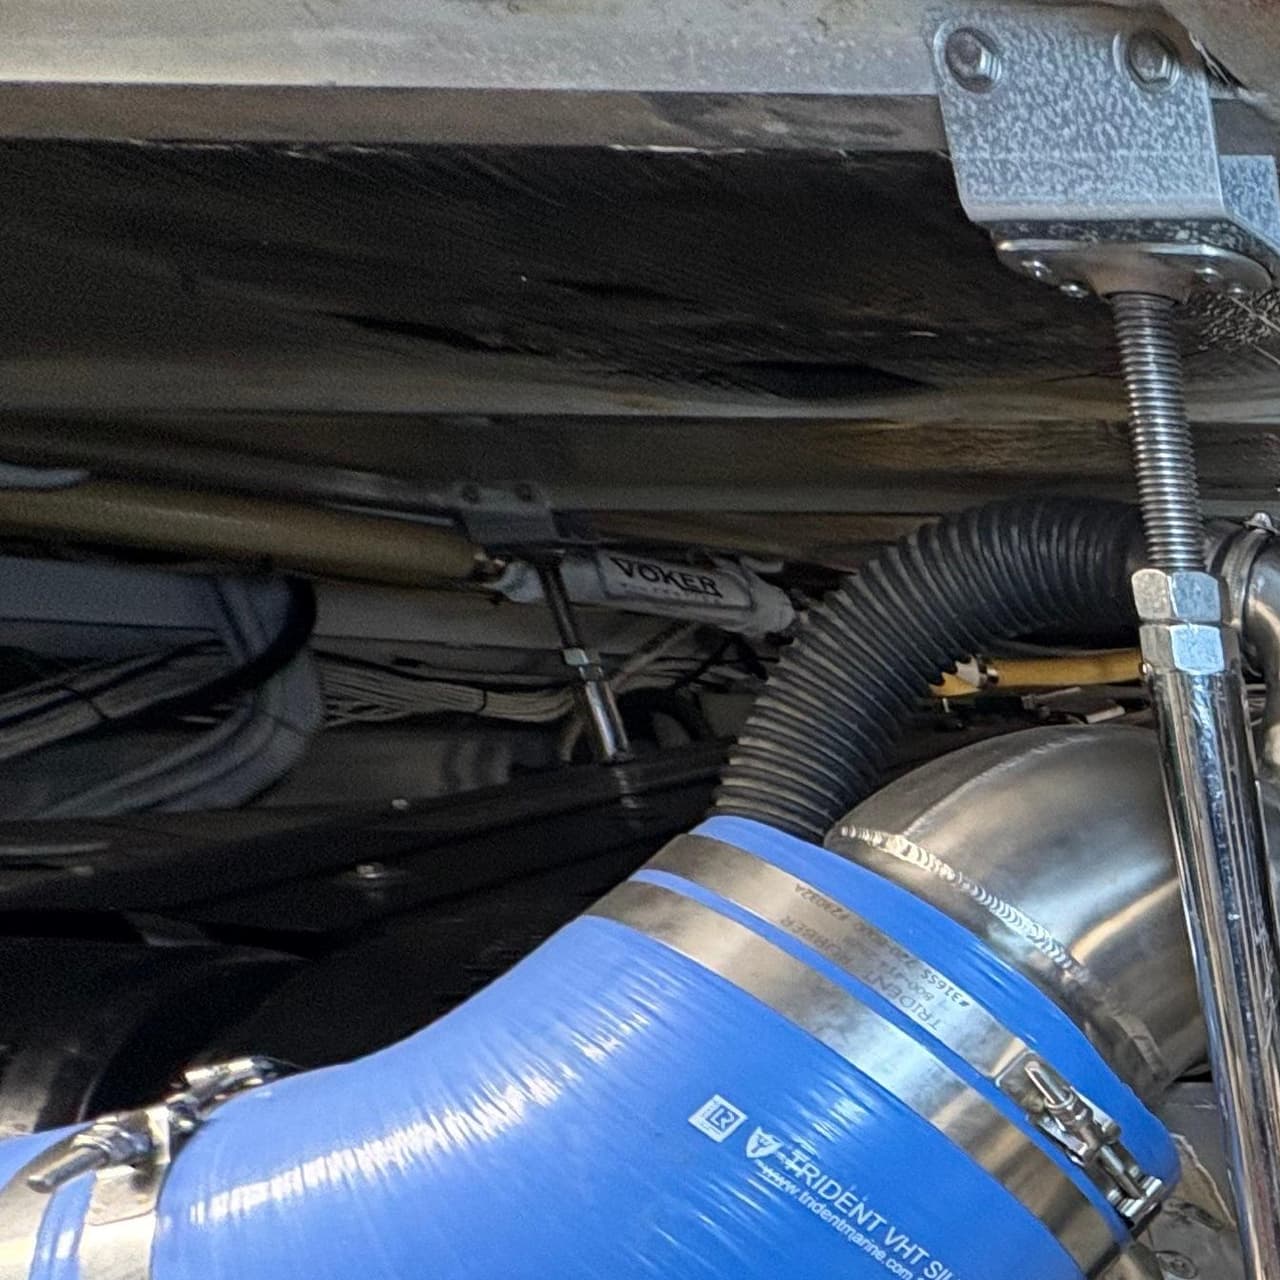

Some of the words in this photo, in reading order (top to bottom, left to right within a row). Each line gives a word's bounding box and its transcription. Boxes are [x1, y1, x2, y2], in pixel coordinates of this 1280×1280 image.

[864, 968, 943, 1032] TRIDENT
[784, 1148, 888, 1236] TRIDENT
[884, 1225, 932, 1268] VHT
